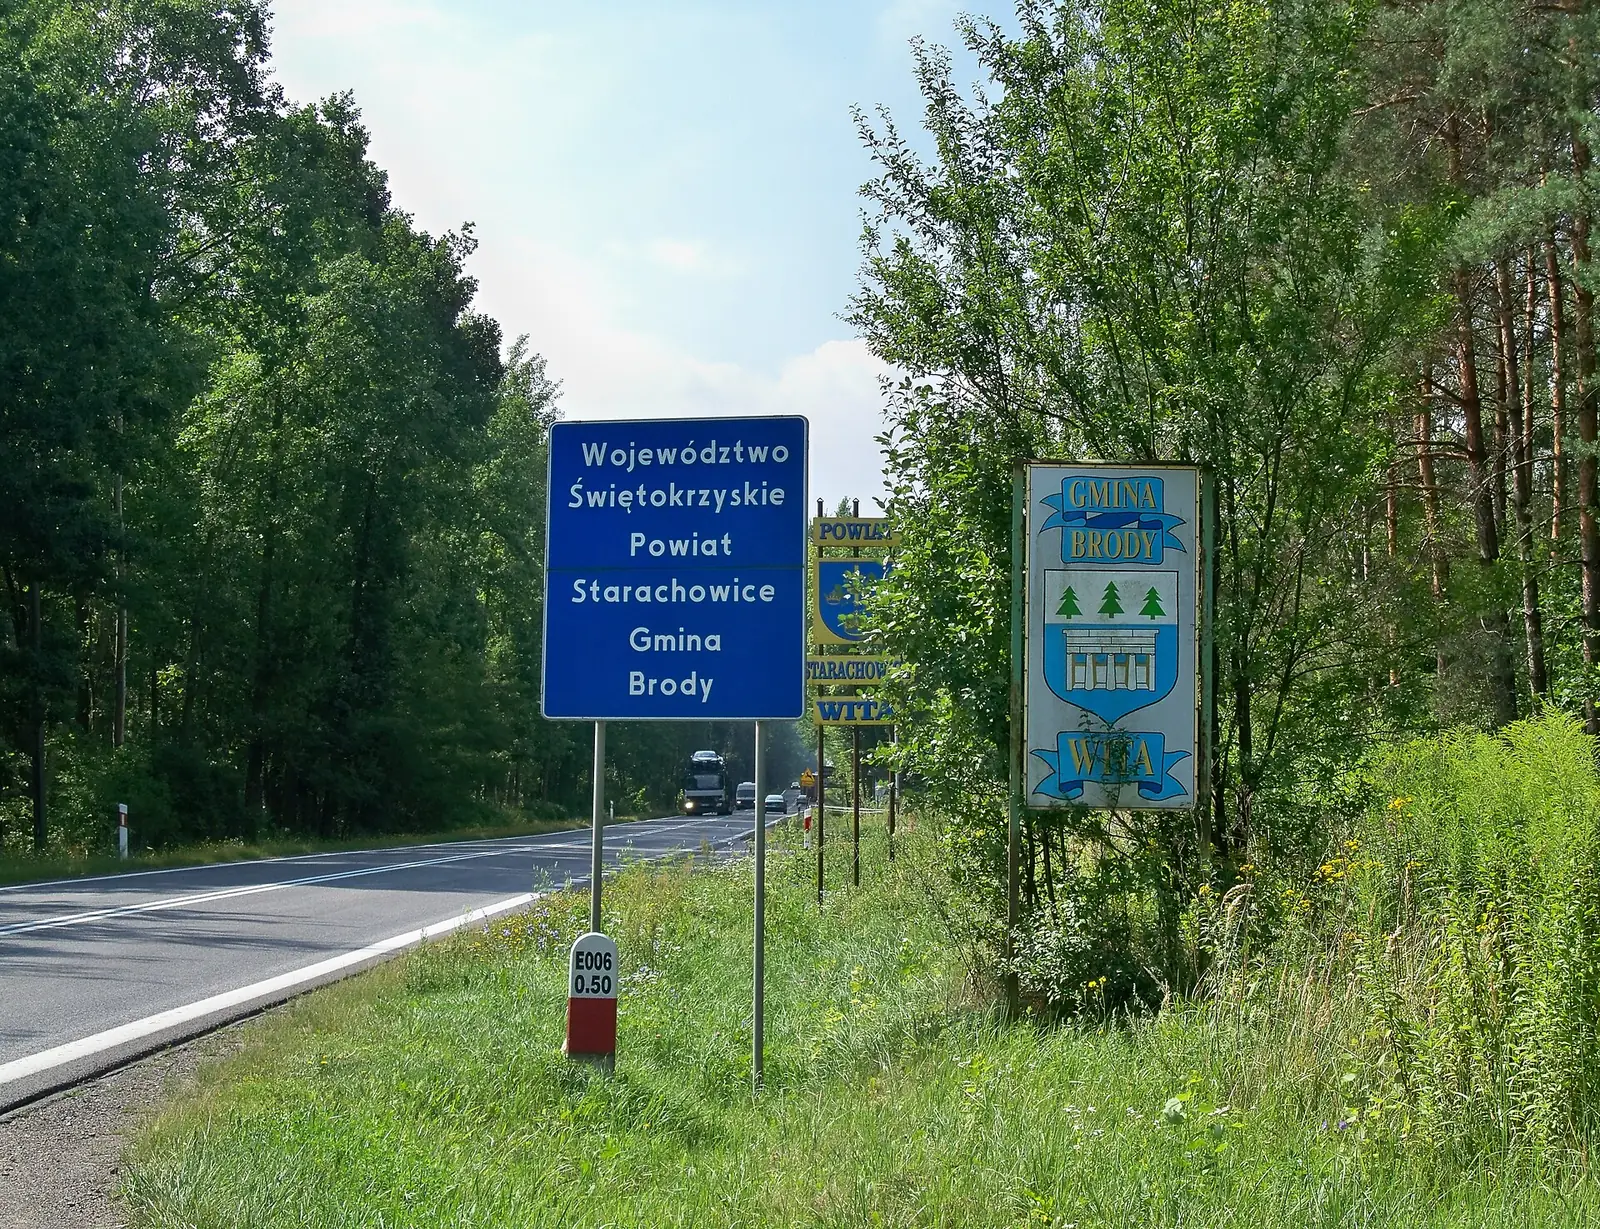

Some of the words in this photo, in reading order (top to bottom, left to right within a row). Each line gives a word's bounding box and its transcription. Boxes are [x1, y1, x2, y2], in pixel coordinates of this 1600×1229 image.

[581, 439, 790, 473] Województwo
[568, 476, 786, 514] Świętokrzyskie
[1069, 479, 1158, 509] GMINA
[630, 532, 732, 557] Powiat
[1070, 530, 1157, 560] BRODY
[571, 578, 775, 603] Starachowice
[629, 627, 722, 652] Gmina
[629, 671, 714, 703] Brody
[816, 701, 894, 720] WITA
[1068, 739, 1156, 776] WITA
[575, 951, 612, 971] E006
[574, 974, 612, 995] 0.50
